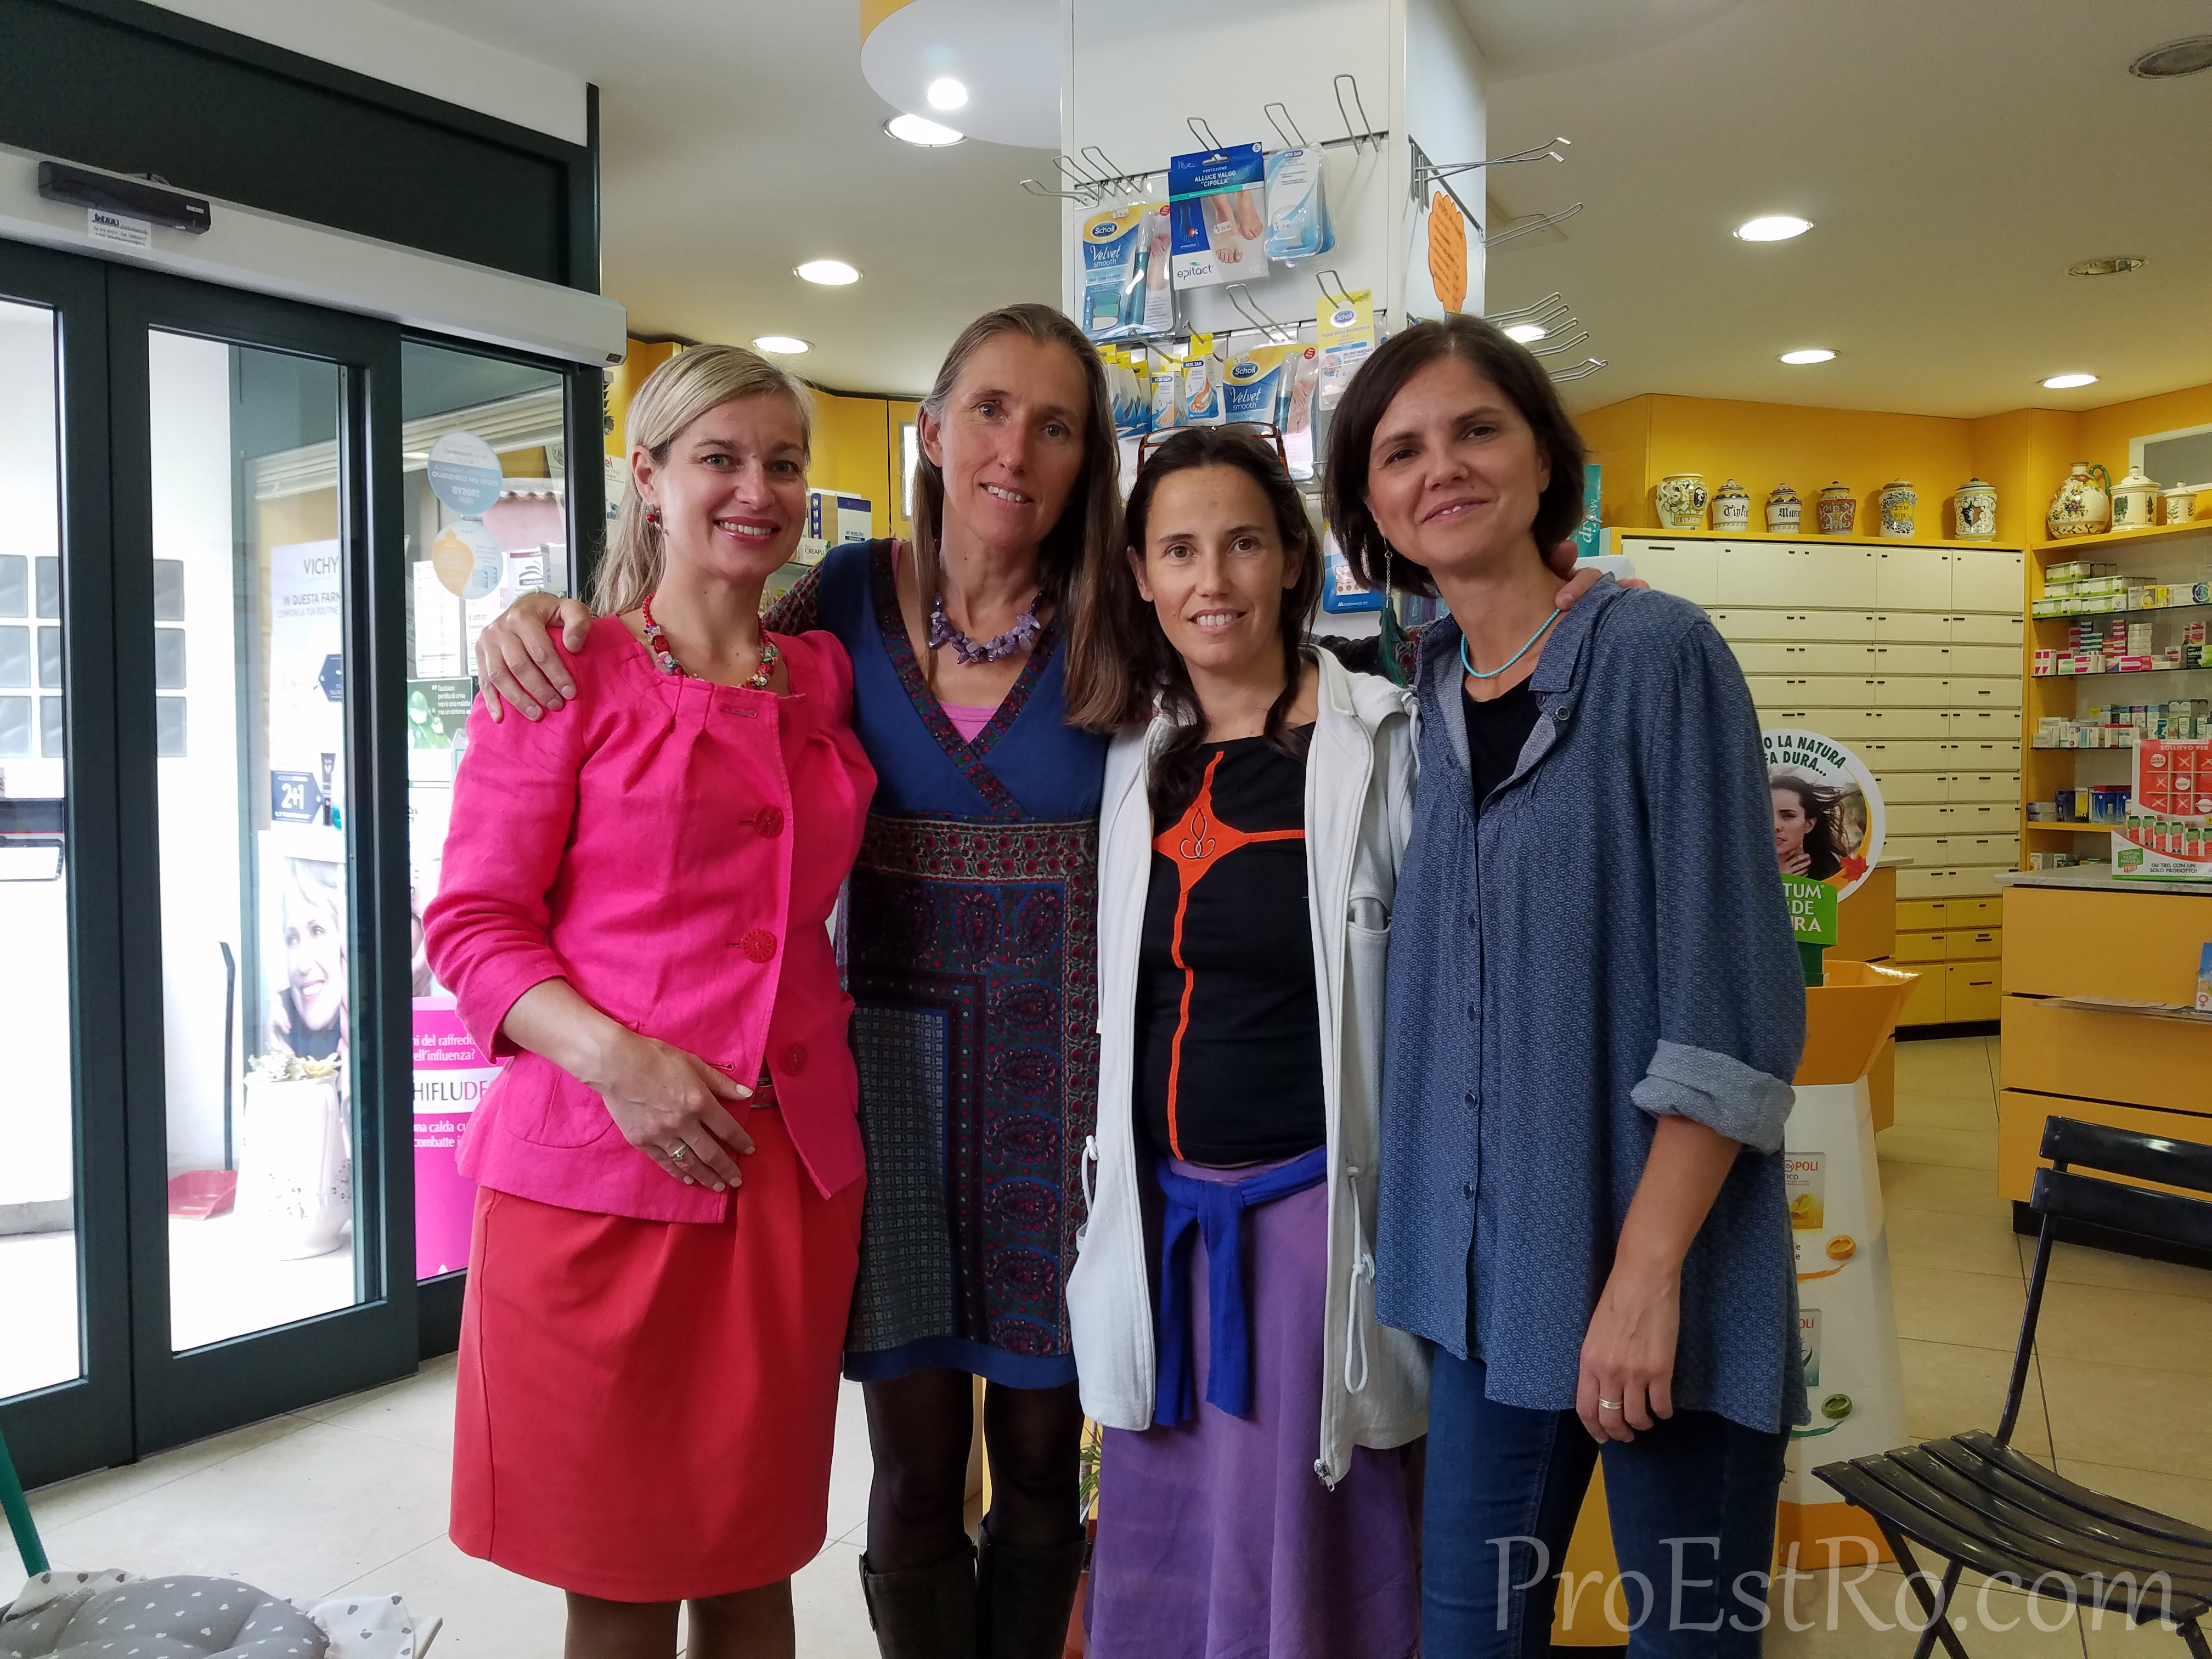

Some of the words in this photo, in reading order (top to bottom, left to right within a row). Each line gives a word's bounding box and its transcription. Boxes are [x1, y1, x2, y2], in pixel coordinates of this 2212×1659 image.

[1194, 173, 1217, 183] ALLUCE
[1217, 170, 1236, 178] VALGO
[1094, 225, 1115, 234] Scholl
[1090, 244, 1121, 261] Velvet
[1093, 258, 1116, 268] smooth
[1177, 264, 1212, 280] epitact
[1336, 312, 1352, 321] Scholl
[1234, 365, 1256, 375] Scholl
[1229, 387, 1262, 404] Velvet
[1233, 401, 1257, 411] smooth
[303, 556, 340, 575] VICHY
[283, 595, 291, 606] IN
[292, 593, 319, 606] QUESTA
[1778, 735, 1792, 748] LA
[1797, 736, 1847, 769] NATURA
[1782, 751, 1827, 777] DURA...
[421, 1034, 436, 1046] del
[428, 1120, 455, 1133] calda
[413, 1135, 455, 1148] combatte
[1795, 1160, 1819, 1171] POLI
